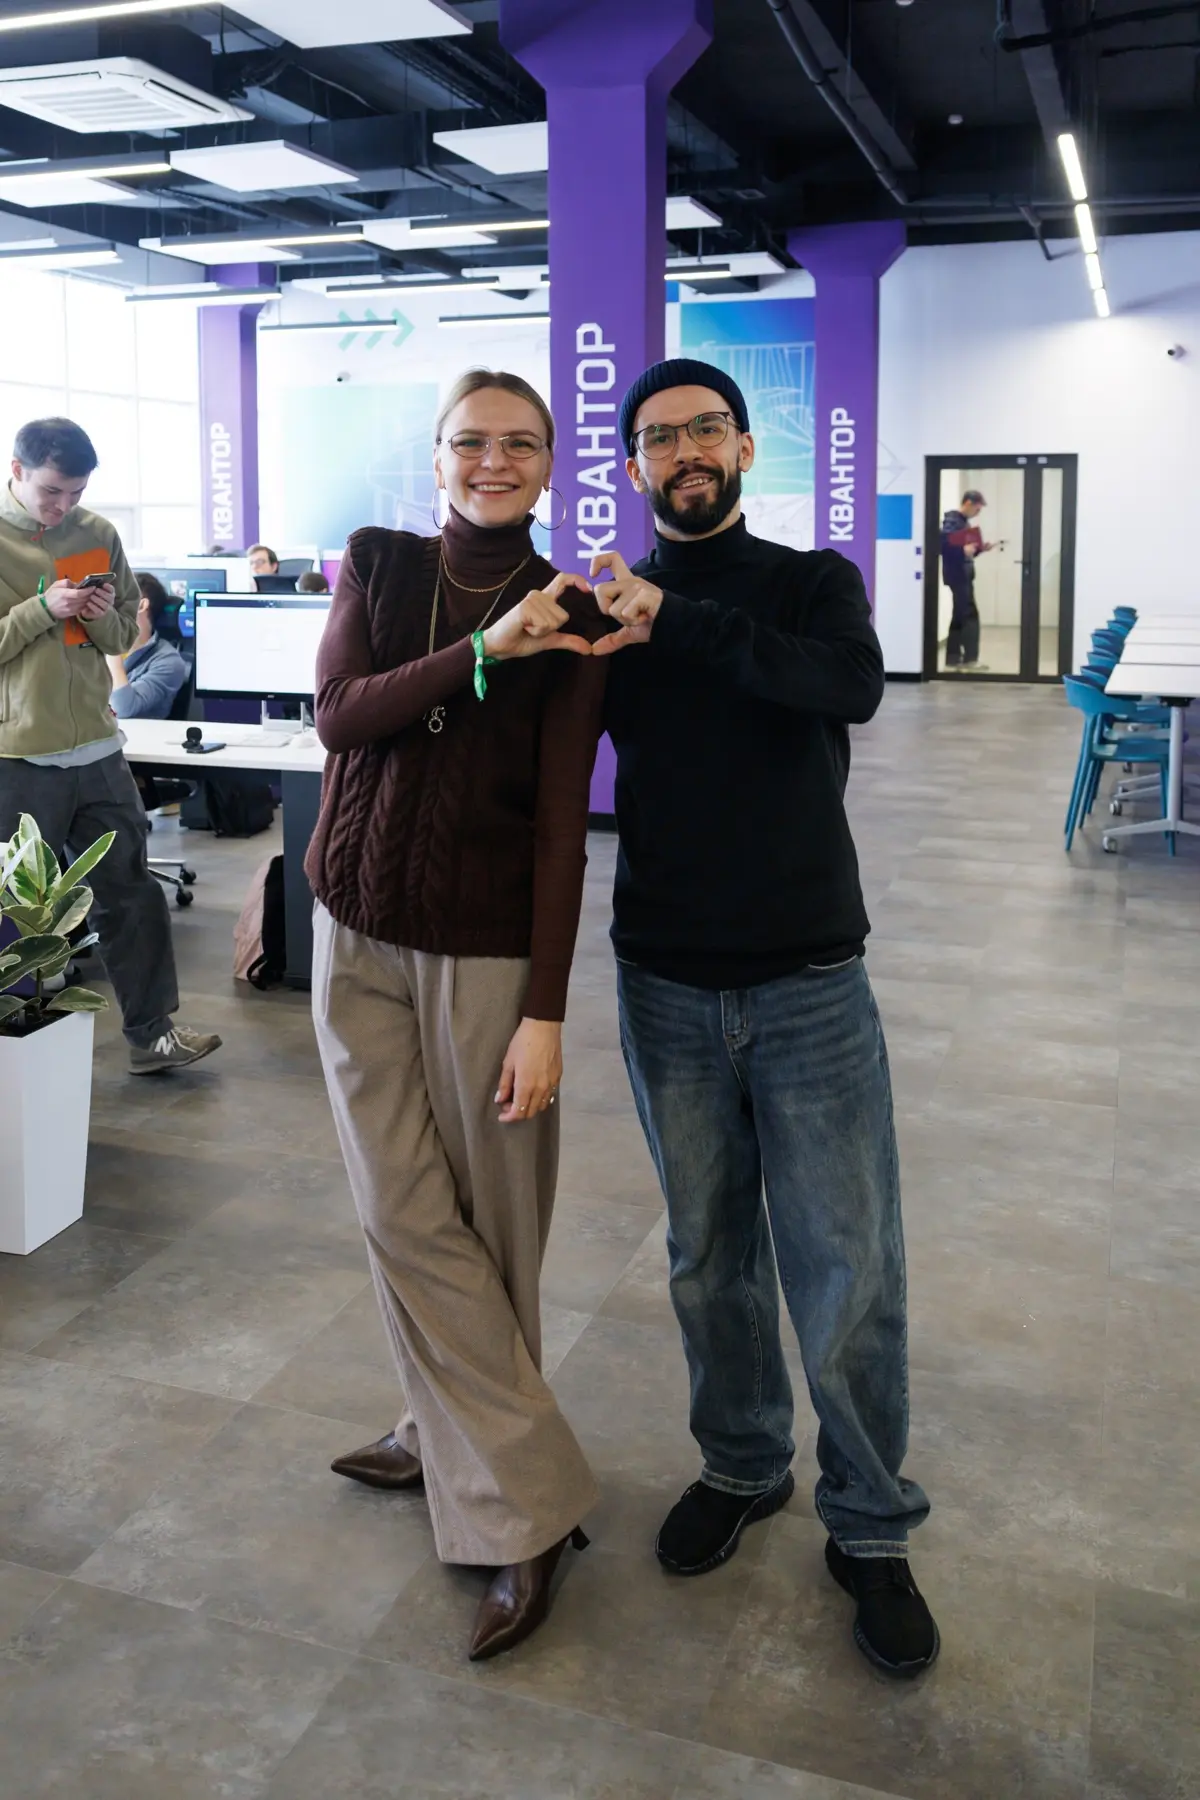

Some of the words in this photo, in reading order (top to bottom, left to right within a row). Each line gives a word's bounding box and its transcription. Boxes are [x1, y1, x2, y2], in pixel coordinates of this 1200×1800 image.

[210, 422, 234, 540] КВАНТОР
[576, 322, 617, 559] КВАНТОР
[829, 407, 856, 541] КВАНТОР
